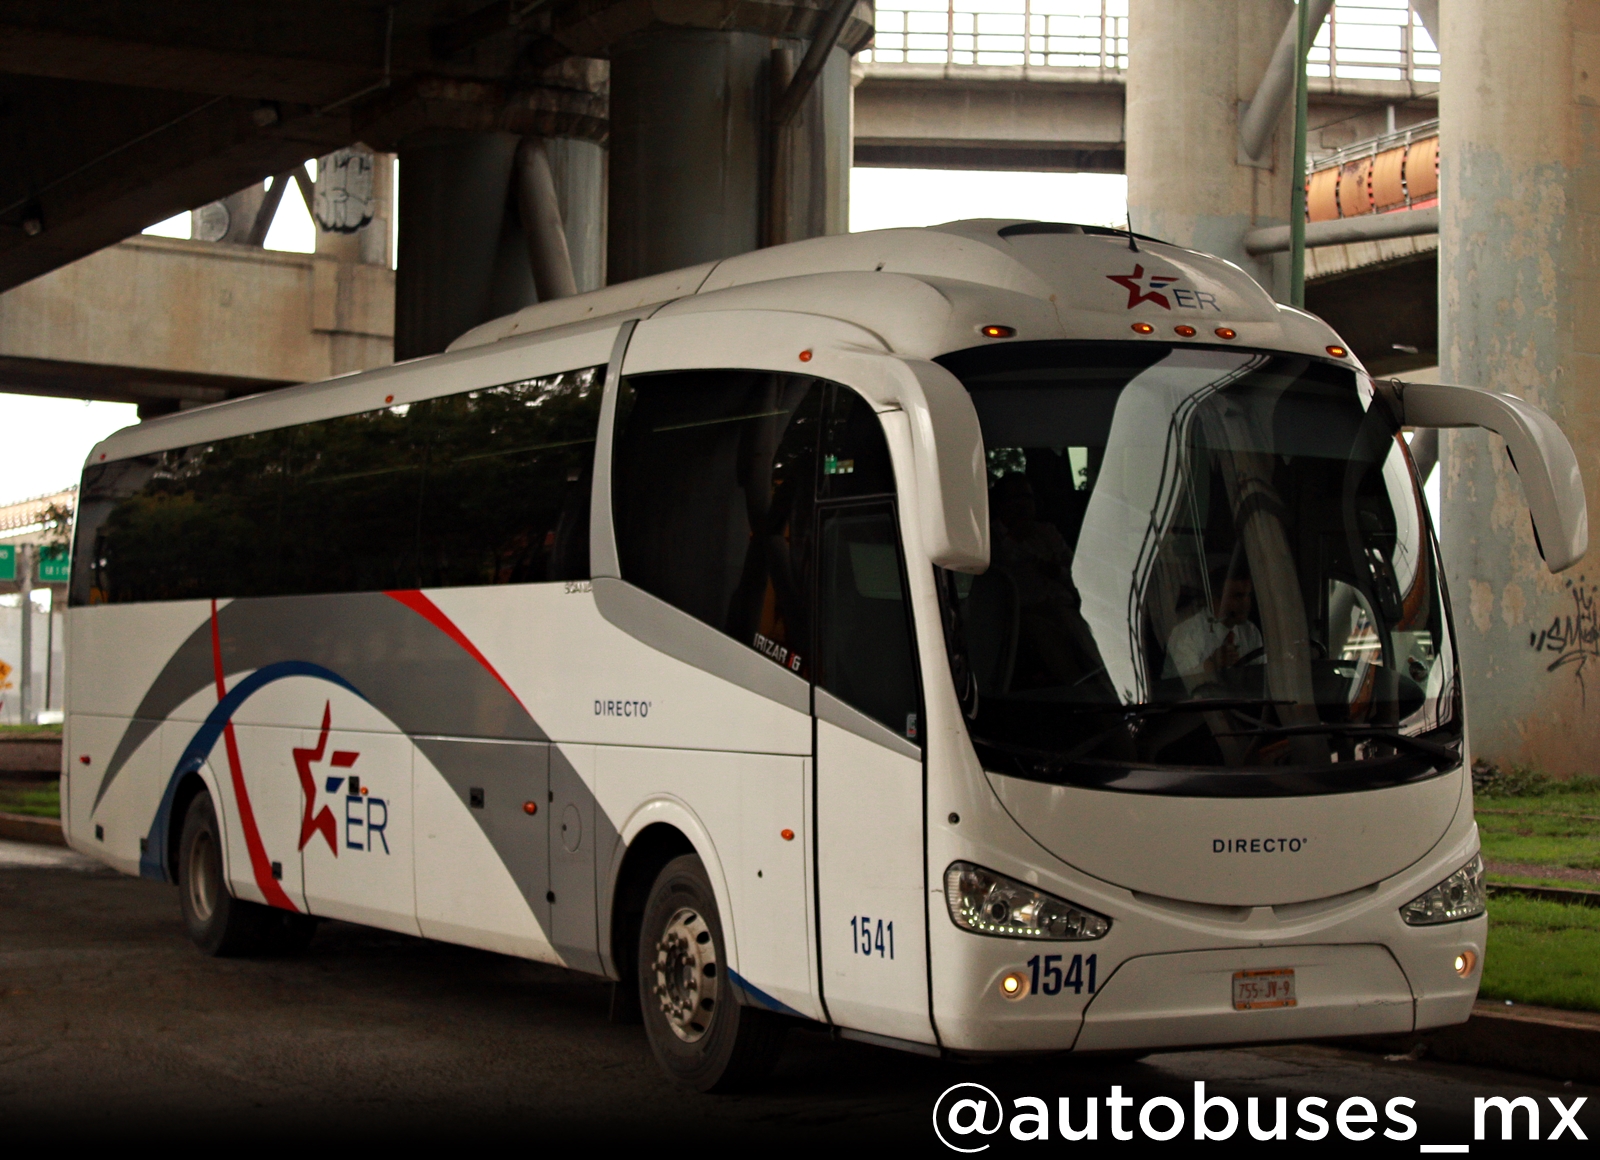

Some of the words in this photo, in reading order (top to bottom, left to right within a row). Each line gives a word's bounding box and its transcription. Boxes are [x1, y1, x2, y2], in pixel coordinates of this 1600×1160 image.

[1173, 289, 1221, 312] ER
[753, 632, 788, 664] IRIZAR
[594, 700, 649, 718] DIRECTO
[346, 795, 390, 855] ER
[1213, 838, 1301, 853] DIRECTO
[851, 915, 894, 960] 1541
[1027, 953, 1097, 996] 1541
